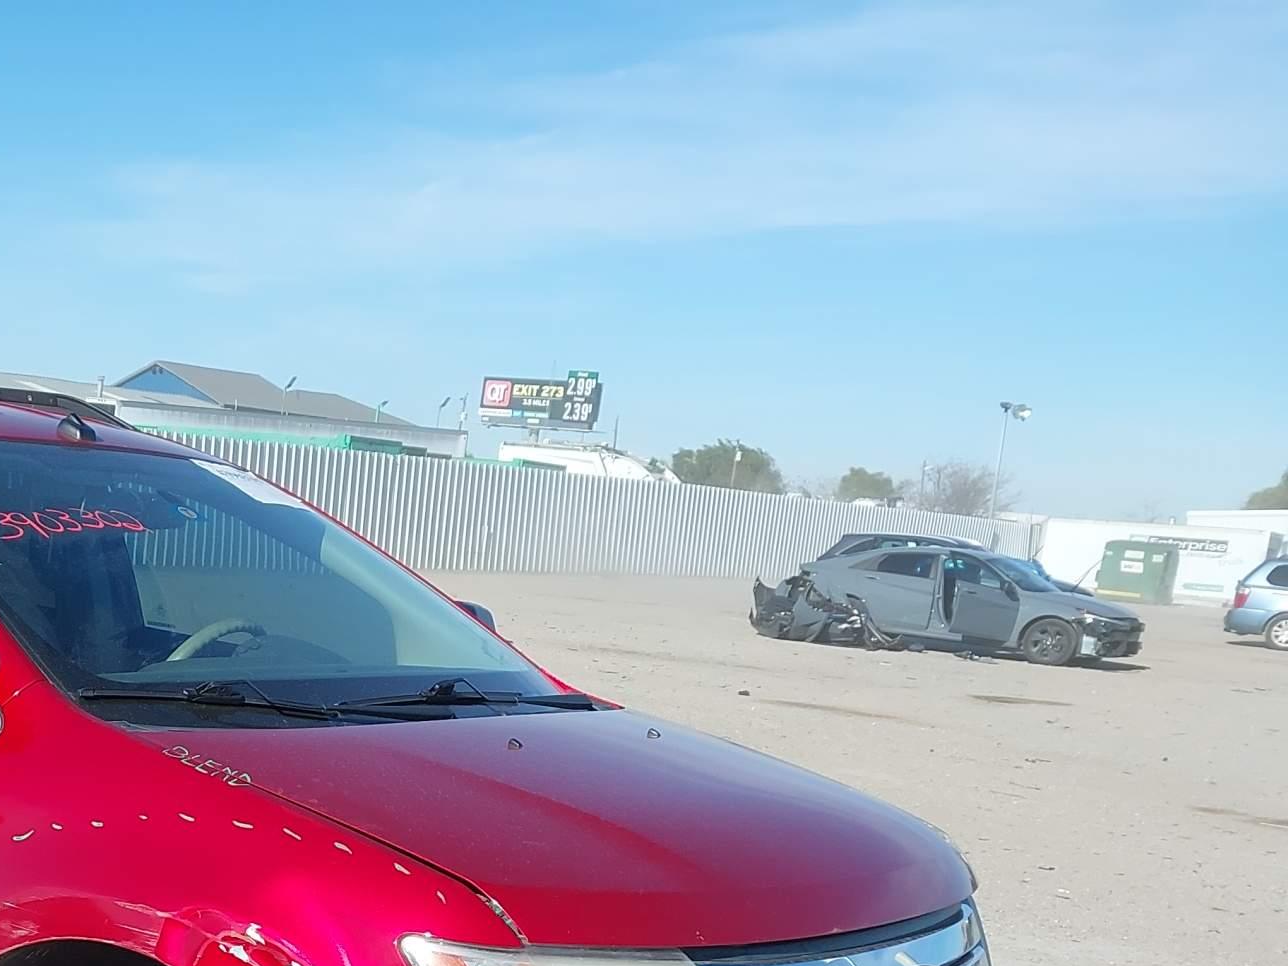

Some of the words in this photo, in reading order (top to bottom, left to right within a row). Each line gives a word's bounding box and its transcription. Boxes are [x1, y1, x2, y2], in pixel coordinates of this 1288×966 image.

[487, 383, 508, 403] QT
[512, 384, 540, 396] EXIT
[541, 386, 565, 398] 273
